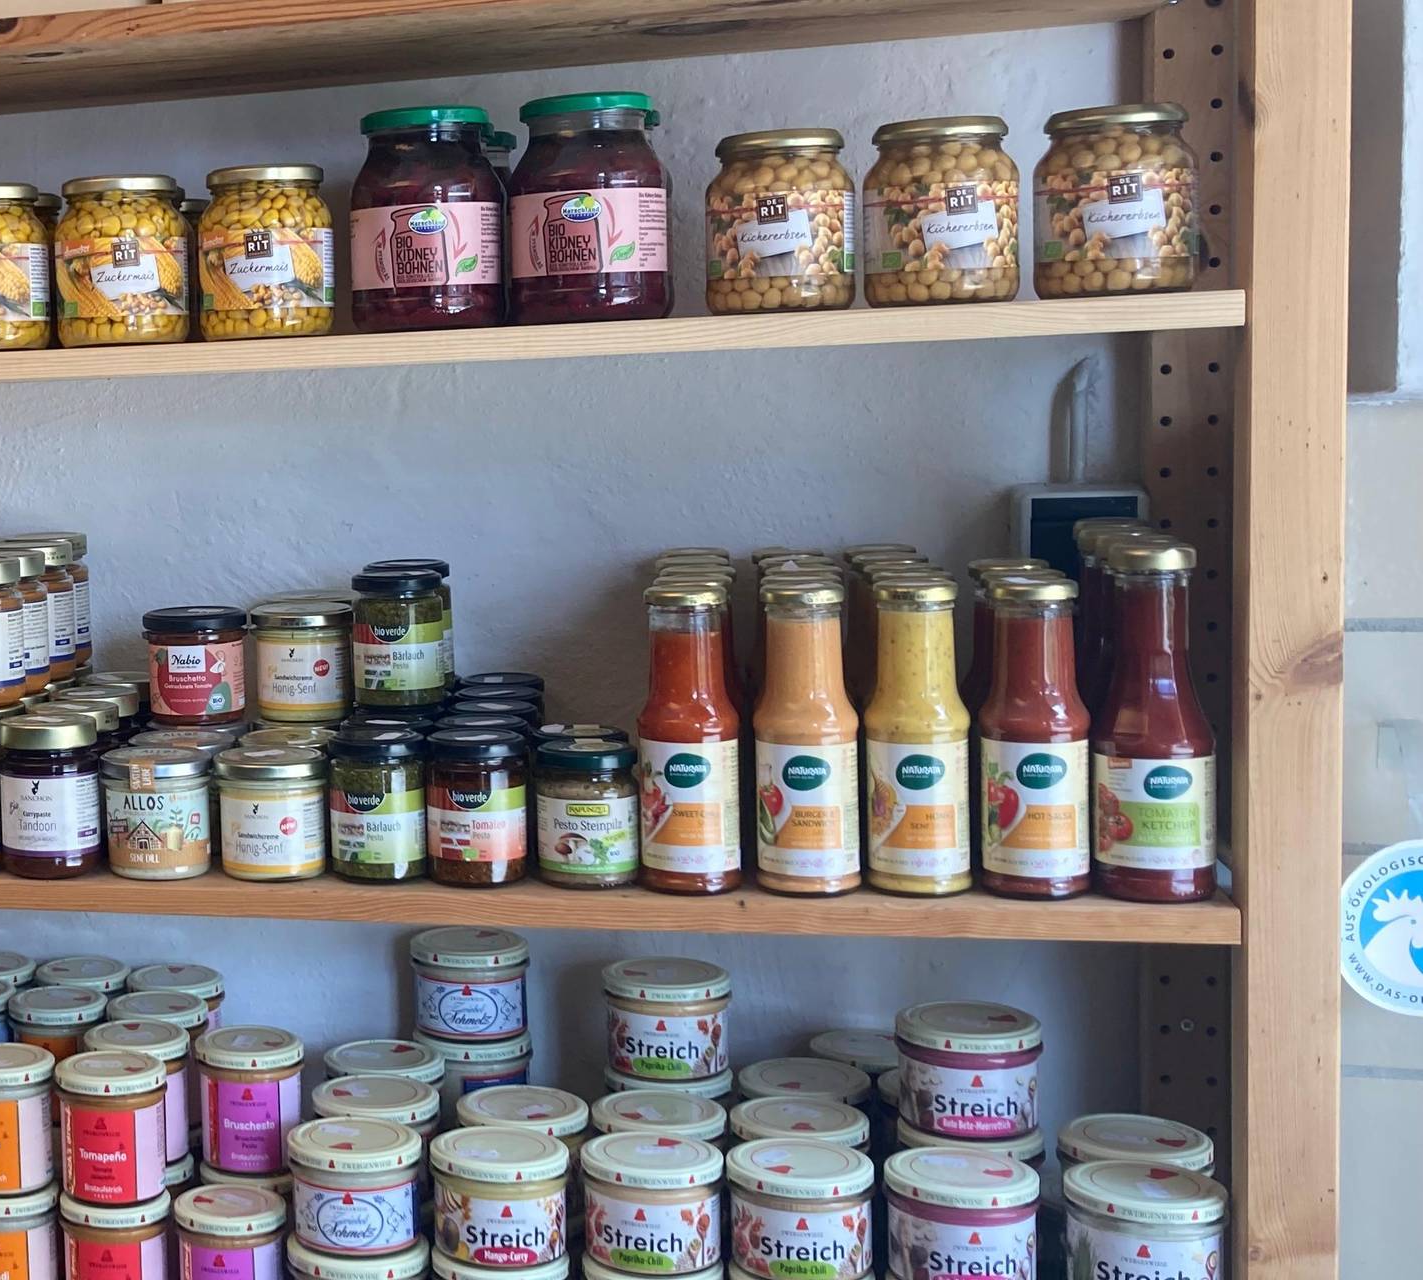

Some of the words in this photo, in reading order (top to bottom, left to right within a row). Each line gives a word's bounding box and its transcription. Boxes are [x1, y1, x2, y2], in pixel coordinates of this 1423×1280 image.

[1112, 182, 1138, 196] RIT
[949, 194, 974, 208] RIT
[760, 204, 785, 217] RIT
[1087, 209, 1161, 224] Kichererbsen
[548, 223, 565, 237] BIO
[926, 221, 994, 235] Kichererbsen
[396, 236, 413, 249] BIO
[549, 235, 591, 250] KIDNEY
[740, 229, 808, 244] Kichererbsen
[120, 244, 130, 252] DE
[247, 241, 270, 253] RIT
[115, 249, 137, 261] RIT
[397, 247, 438, 262] KIDNEY
[549, 248, 596, 263] BOHNEN
[229, 262, 289, 276] Zuckermais
[397, 260, 444, 275] BOHNEN
[96, 270, 155, 284] Zuckermais
[171, 654, 201, 665] Nabio
[392, 651, 425, 662] Bärlauch
[272, 683, 317, 697] Honig-Senf
[669, 763, 708, 775] NATURATA
[788, 765, 827, 776] NATURATA
[901, 765, 942, 775] NATURATA
[1022, 764, 1063, 774] NATURATA
[1149, 776, 1190, 786] NATURATA
[123, 795, 165, 811] ALLOS
[568, 805, 607, 814] RAPUNZEL
[22, 810, 52, 819] Currypaste
[1138, 808, 1197, 818] TOMATEN
[365, 820, 402, 832] Bärlauch
[553, 818, 578, 831] Pesto
[580, 818, 623, 834] Steinpilz
[1142, 820, 1196, 831] KETCHUP
[237, 831, 280, 841] Sandwichcreme
[235, 839, 284, 857] Honig-Senf
[145, 853, 160, 864] DILL
[1345, 912, 1356, 942] AUS
[625, 1036, 701, 1060] Streich
[934, 1094, 1019, 1118] Streich
[224, 1118, 275, 1131] Bruschesto
[78, 1147, 127, 1164] Tomapeño
[1120, 1208, 1186, 1222] ZWERGENWIESE
[321, 1224, 377, 1241] Schmelz
[465, 1225, 545, 1250] Streich
[603, 1224, 683, 1252] Streich
[760, 1236, 846, 1262] Streich
[483, 1250, 529, 1264] Mango-Curry
[617, 1251, 665, 1267] Paprika-Chili
[779, 1261, 828, 1275] Paprika-Chili
[929, 1251, 1017, 1278] Streich
